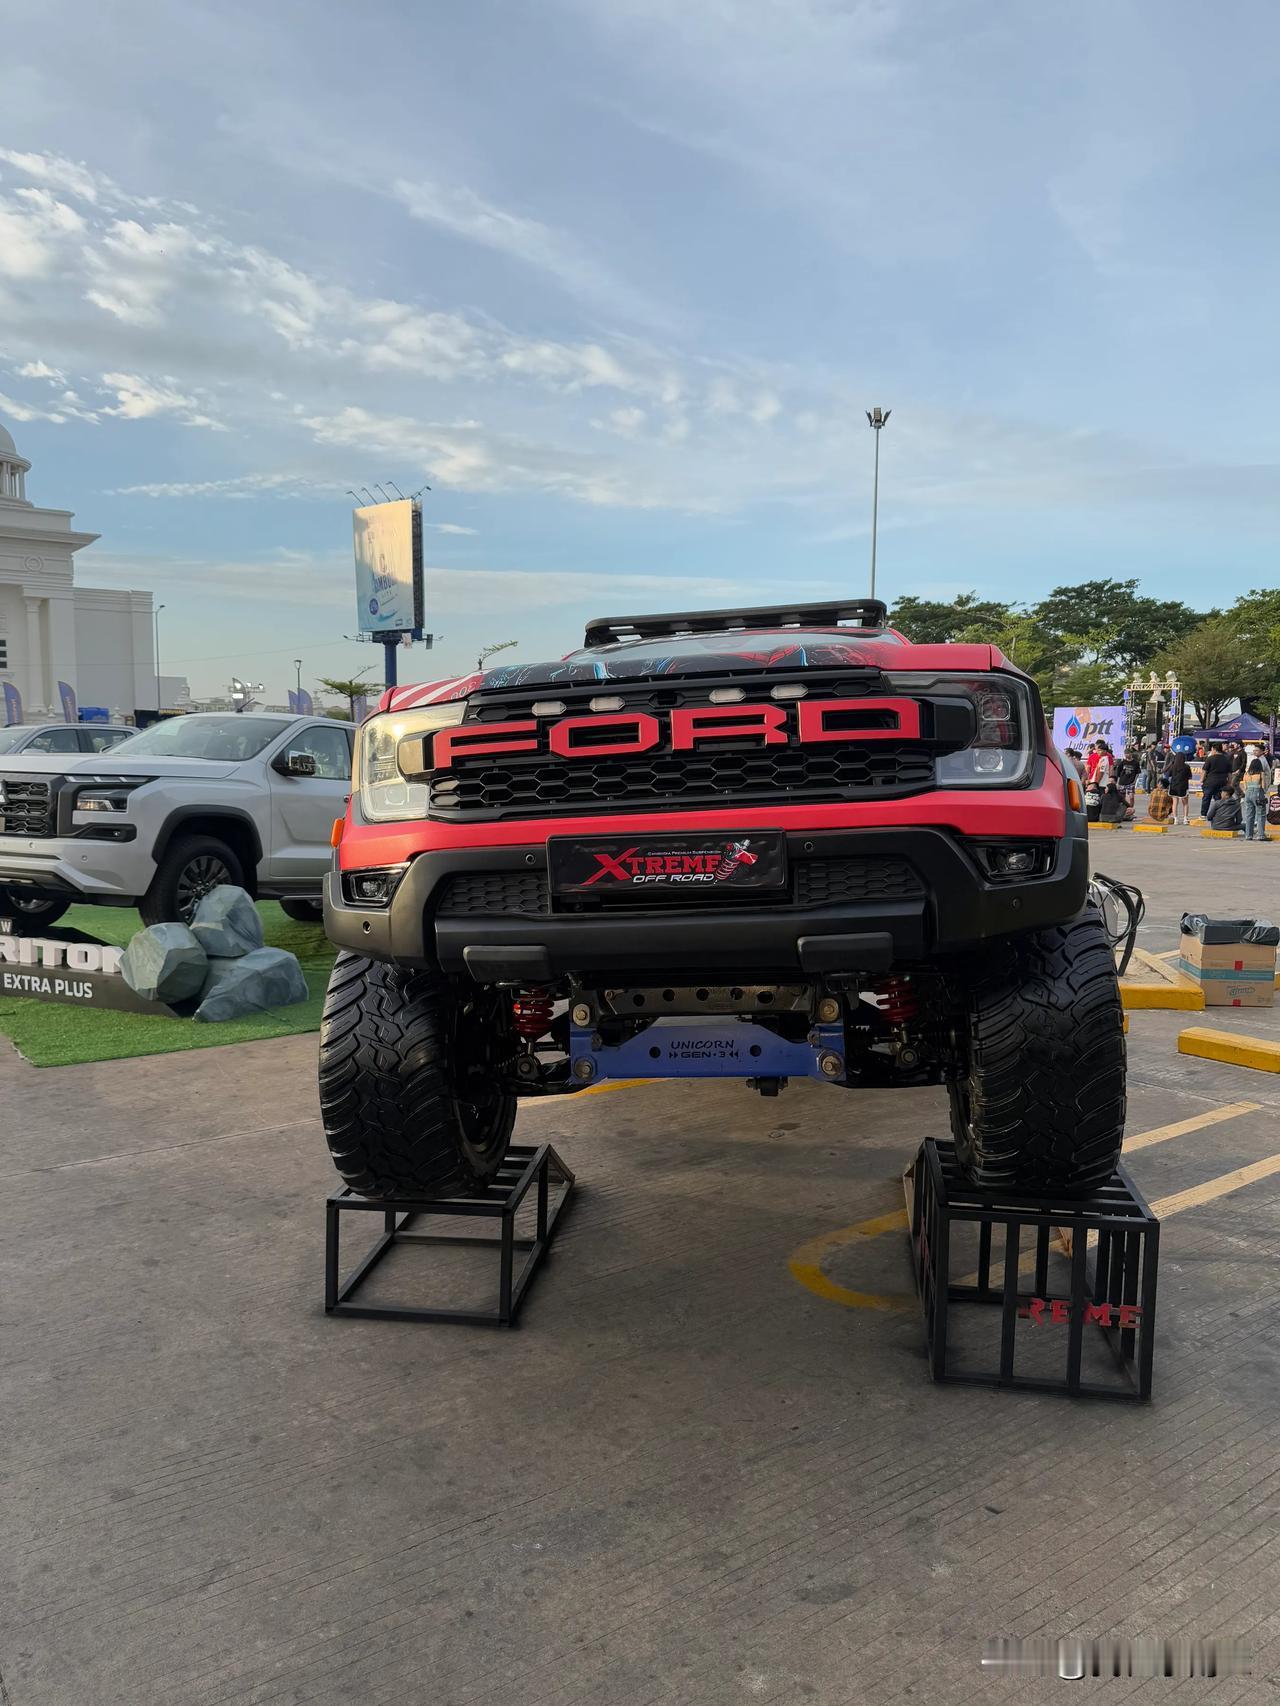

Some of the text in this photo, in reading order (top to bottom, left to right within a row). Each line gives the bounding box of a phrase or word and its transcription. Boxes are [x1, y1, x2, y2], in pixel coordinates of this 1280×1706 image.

[433, 697, 921, 770] FORD
[1082, 719, 1114, 739] ptt
[580, 847, 722, 886] XTREME
[633, 873, 715, 883] OFF ROAD
[3, 973, 93, 998] EXTRA PLUS
[671, 1040, 734, 1049] UNICORN
